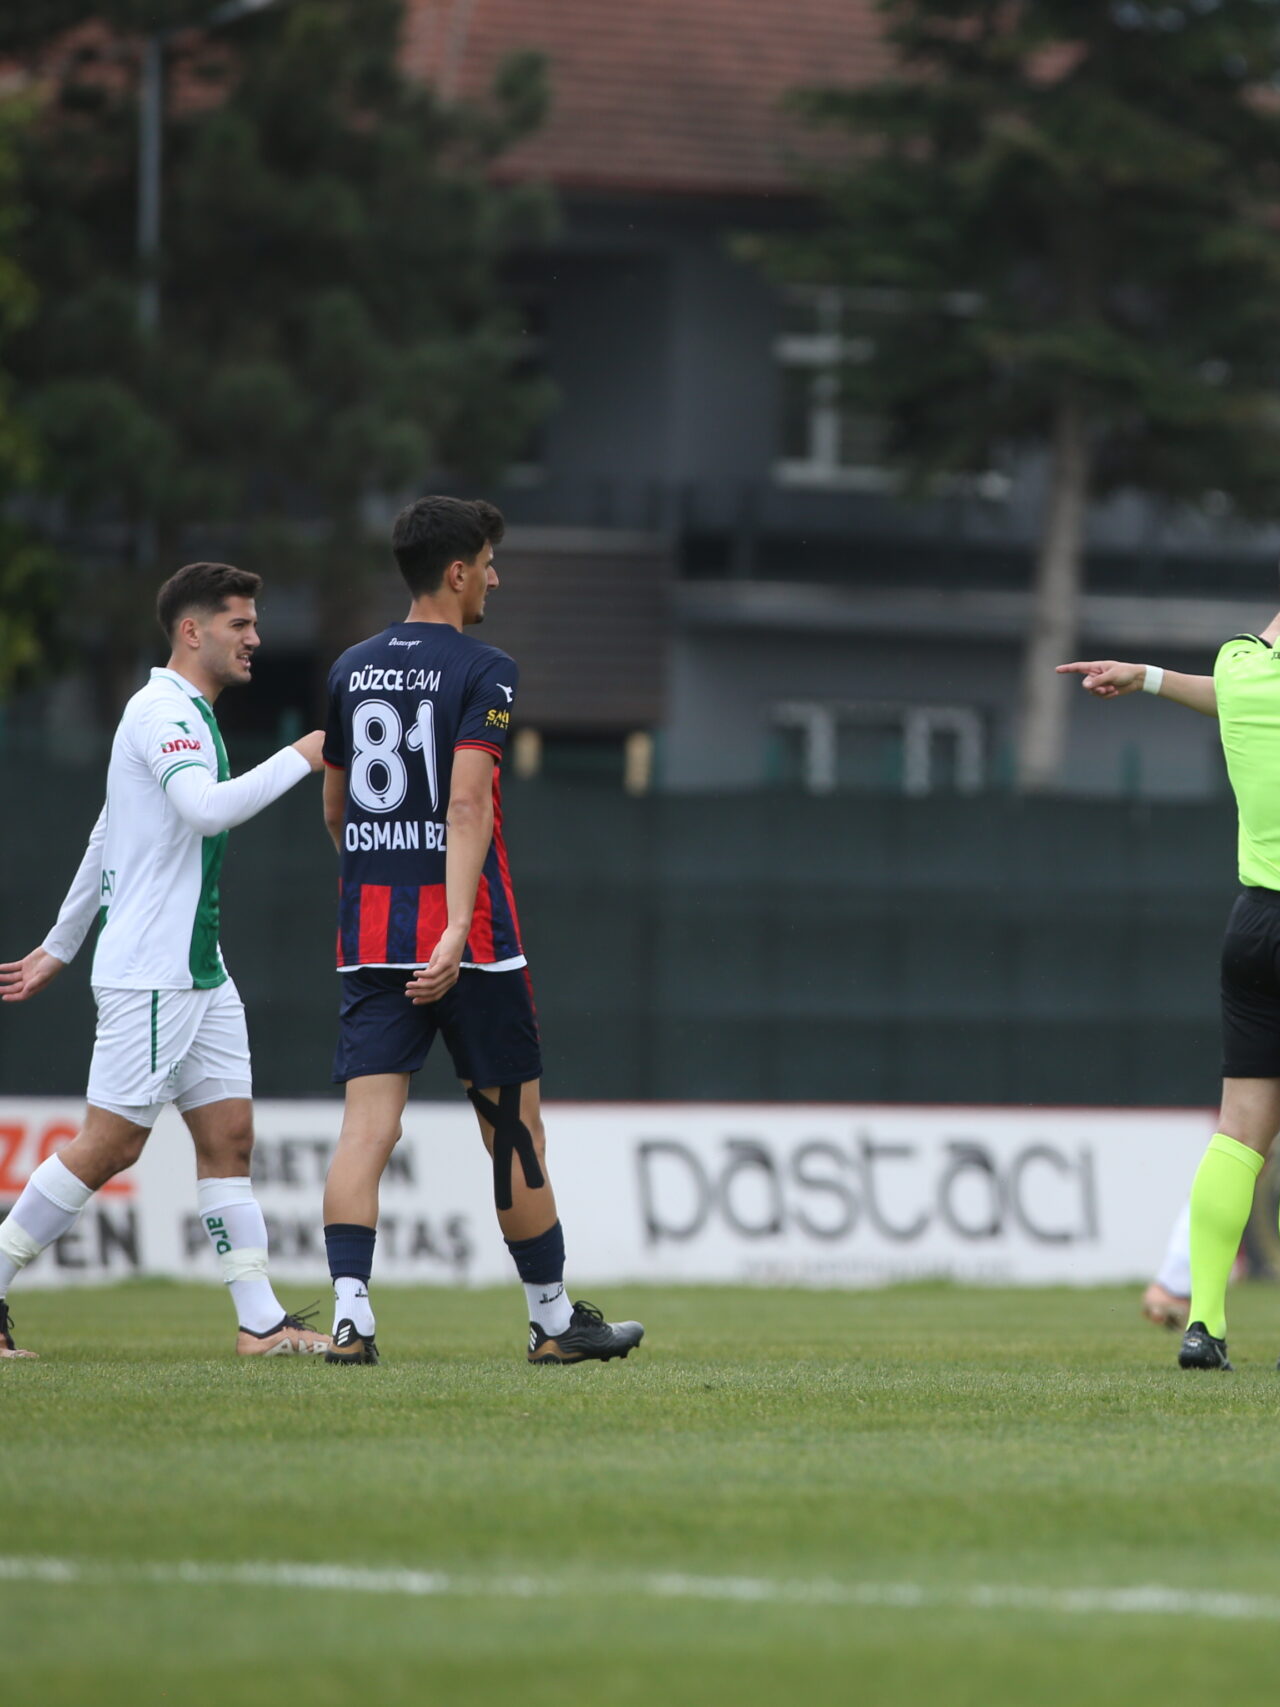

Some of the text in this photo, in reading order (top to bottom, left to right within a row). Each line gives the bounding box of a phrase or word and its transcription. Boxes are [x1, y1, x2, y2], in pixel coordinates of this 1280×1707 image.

[349, 664, 441, 692] DÜZCE CAM
[350, 699, 439, 814] 81
[345, 821, 419, 852] OSMAN
[206, 1217, 232, 1255] aro
